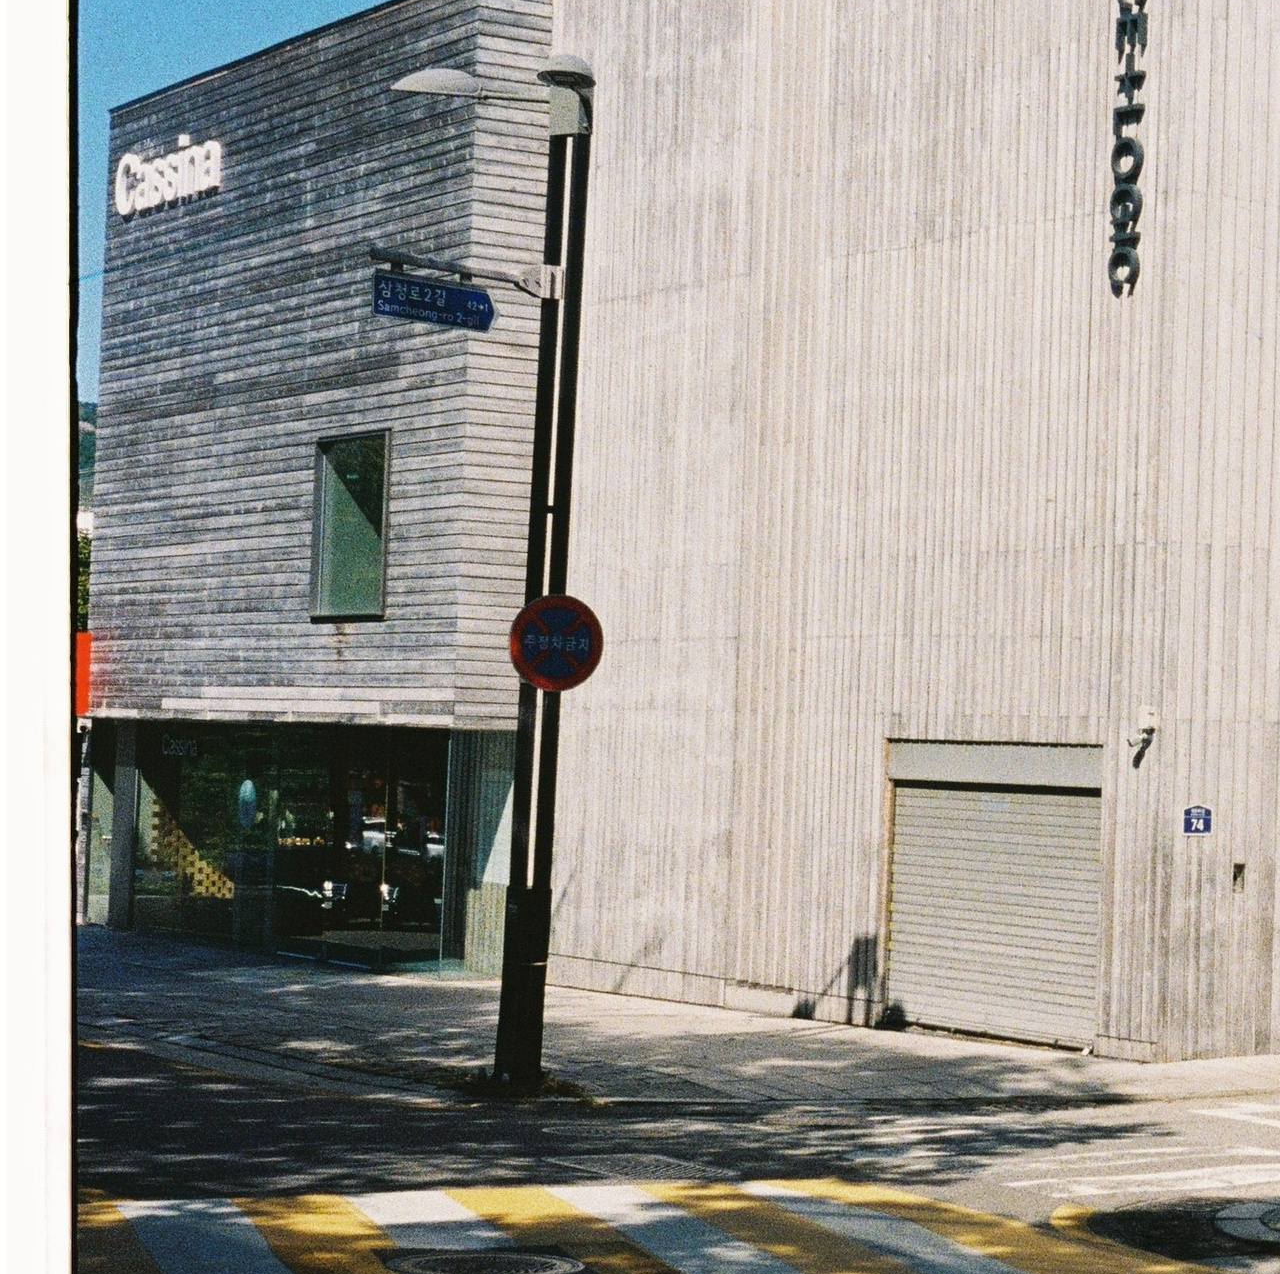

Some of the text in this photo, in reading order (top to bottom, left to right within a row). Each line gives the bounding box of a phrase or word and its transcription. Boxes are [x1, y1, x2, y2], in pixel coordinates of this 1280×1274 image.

[115, 133, 222, 216] Cassina
[378, 279, 447, 307] 삼청로2길
[377, 300, 481, 327] Samcheong-ro 2-gil
[524, 634, 589, 652] 주정차금지
[1191, 819, 1205, 832] 74
